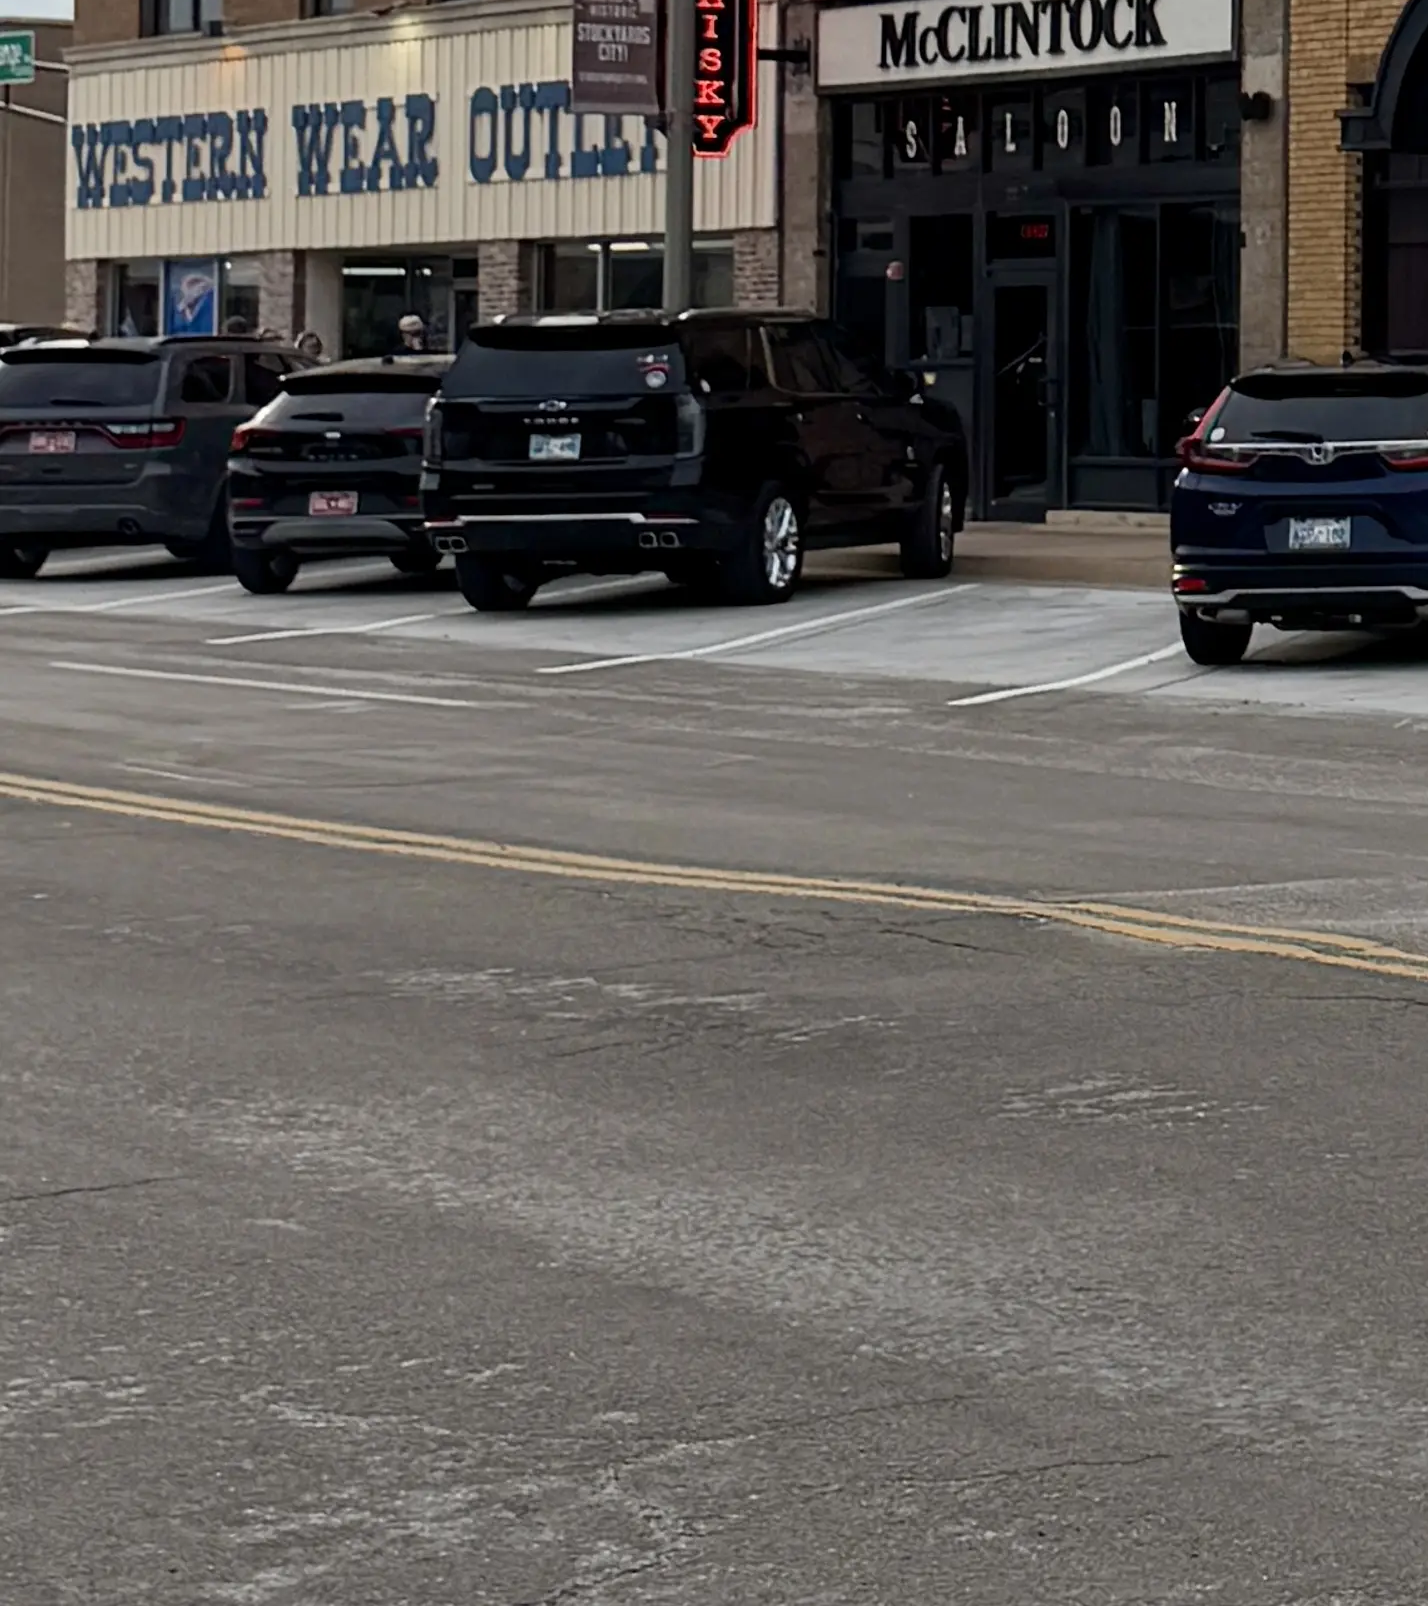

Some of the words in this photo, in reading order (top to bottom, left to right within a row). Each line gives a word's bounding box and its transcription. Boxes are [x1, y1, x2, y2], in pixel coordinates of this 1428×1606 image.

[577, 23, 651, 44] STOCKYARDS
[71, 107, 269, 209] WESTERN
[292, 93, 440, 197] WEAR
[906, 101, 1178, 159] SALOON
